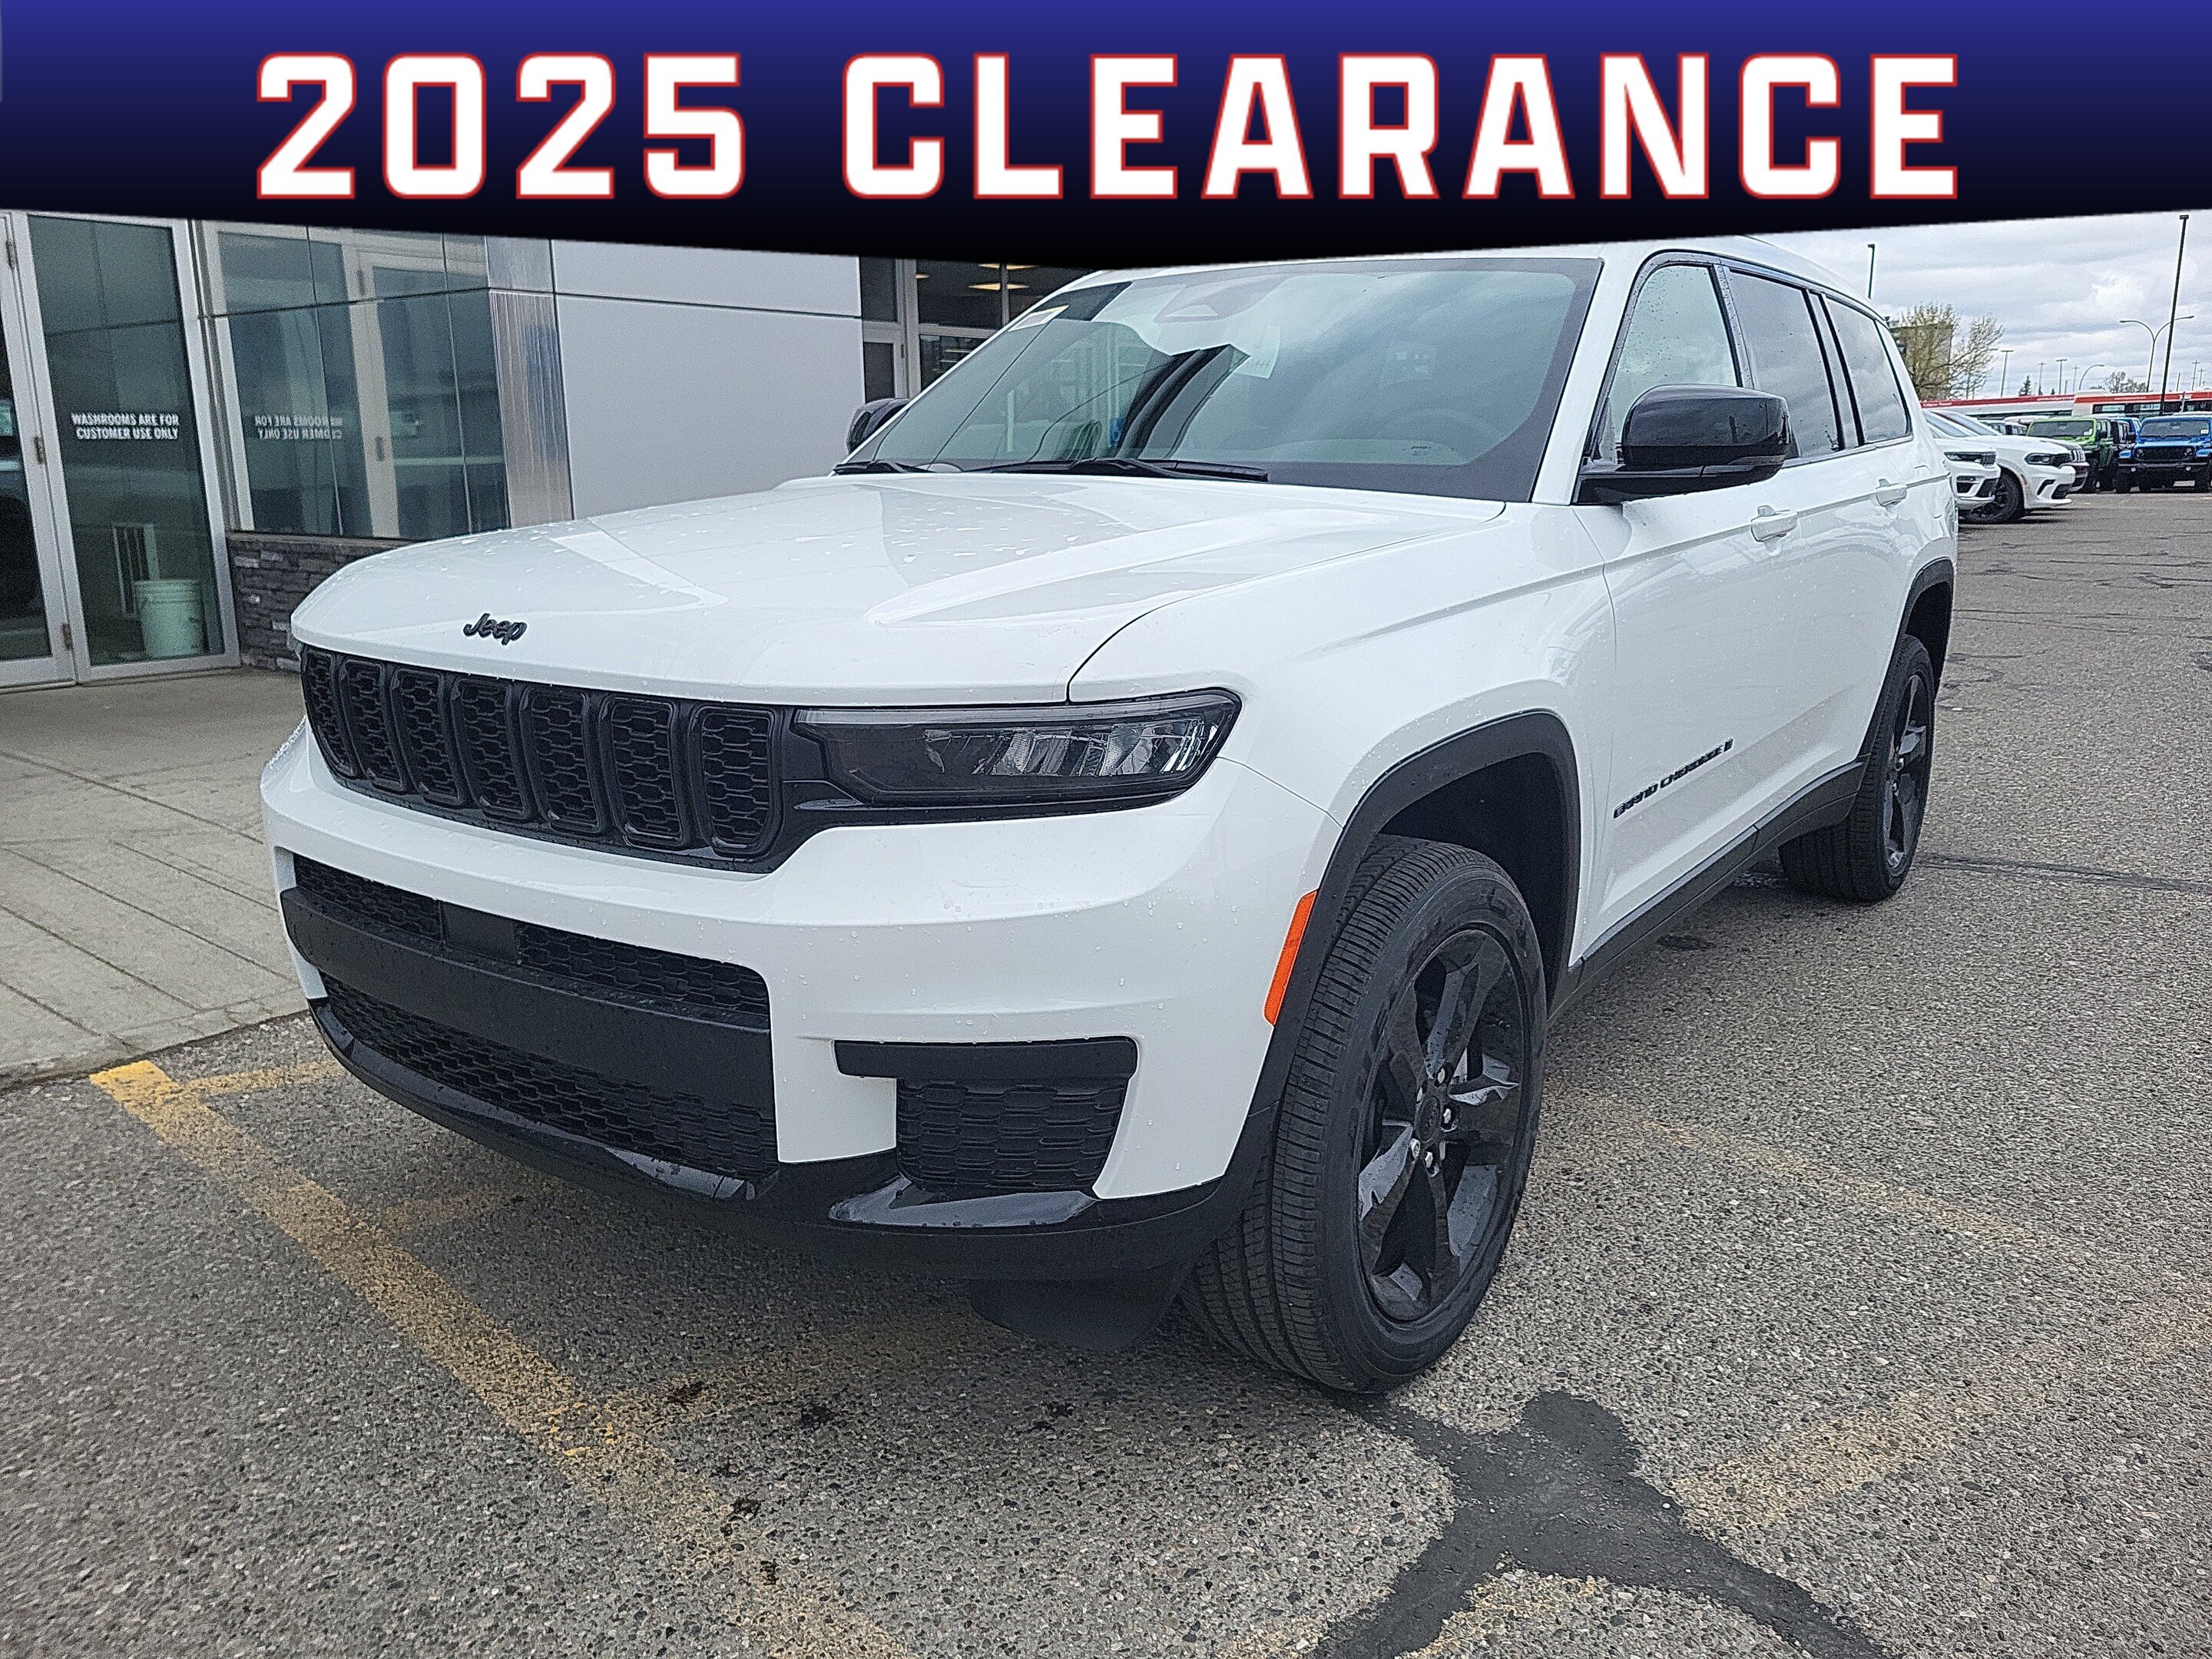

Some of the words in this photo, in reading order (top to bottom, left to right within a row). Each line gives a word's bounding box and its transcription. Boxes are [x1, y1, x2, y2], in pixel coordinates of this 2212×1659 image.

[71, 412, 137, 426] WASHROOMS
[138, 412, 158, 426] ARE
[159, 412, 179, 426] FOR
[77, 427, 131, 440] CUSTOMER
[132, 427, 153, 440] USE
[154, 427, 178, 440] ONLY
[462, 613, 527, 646] Jeep
[1613, 783, 1658, 819] GRAND
